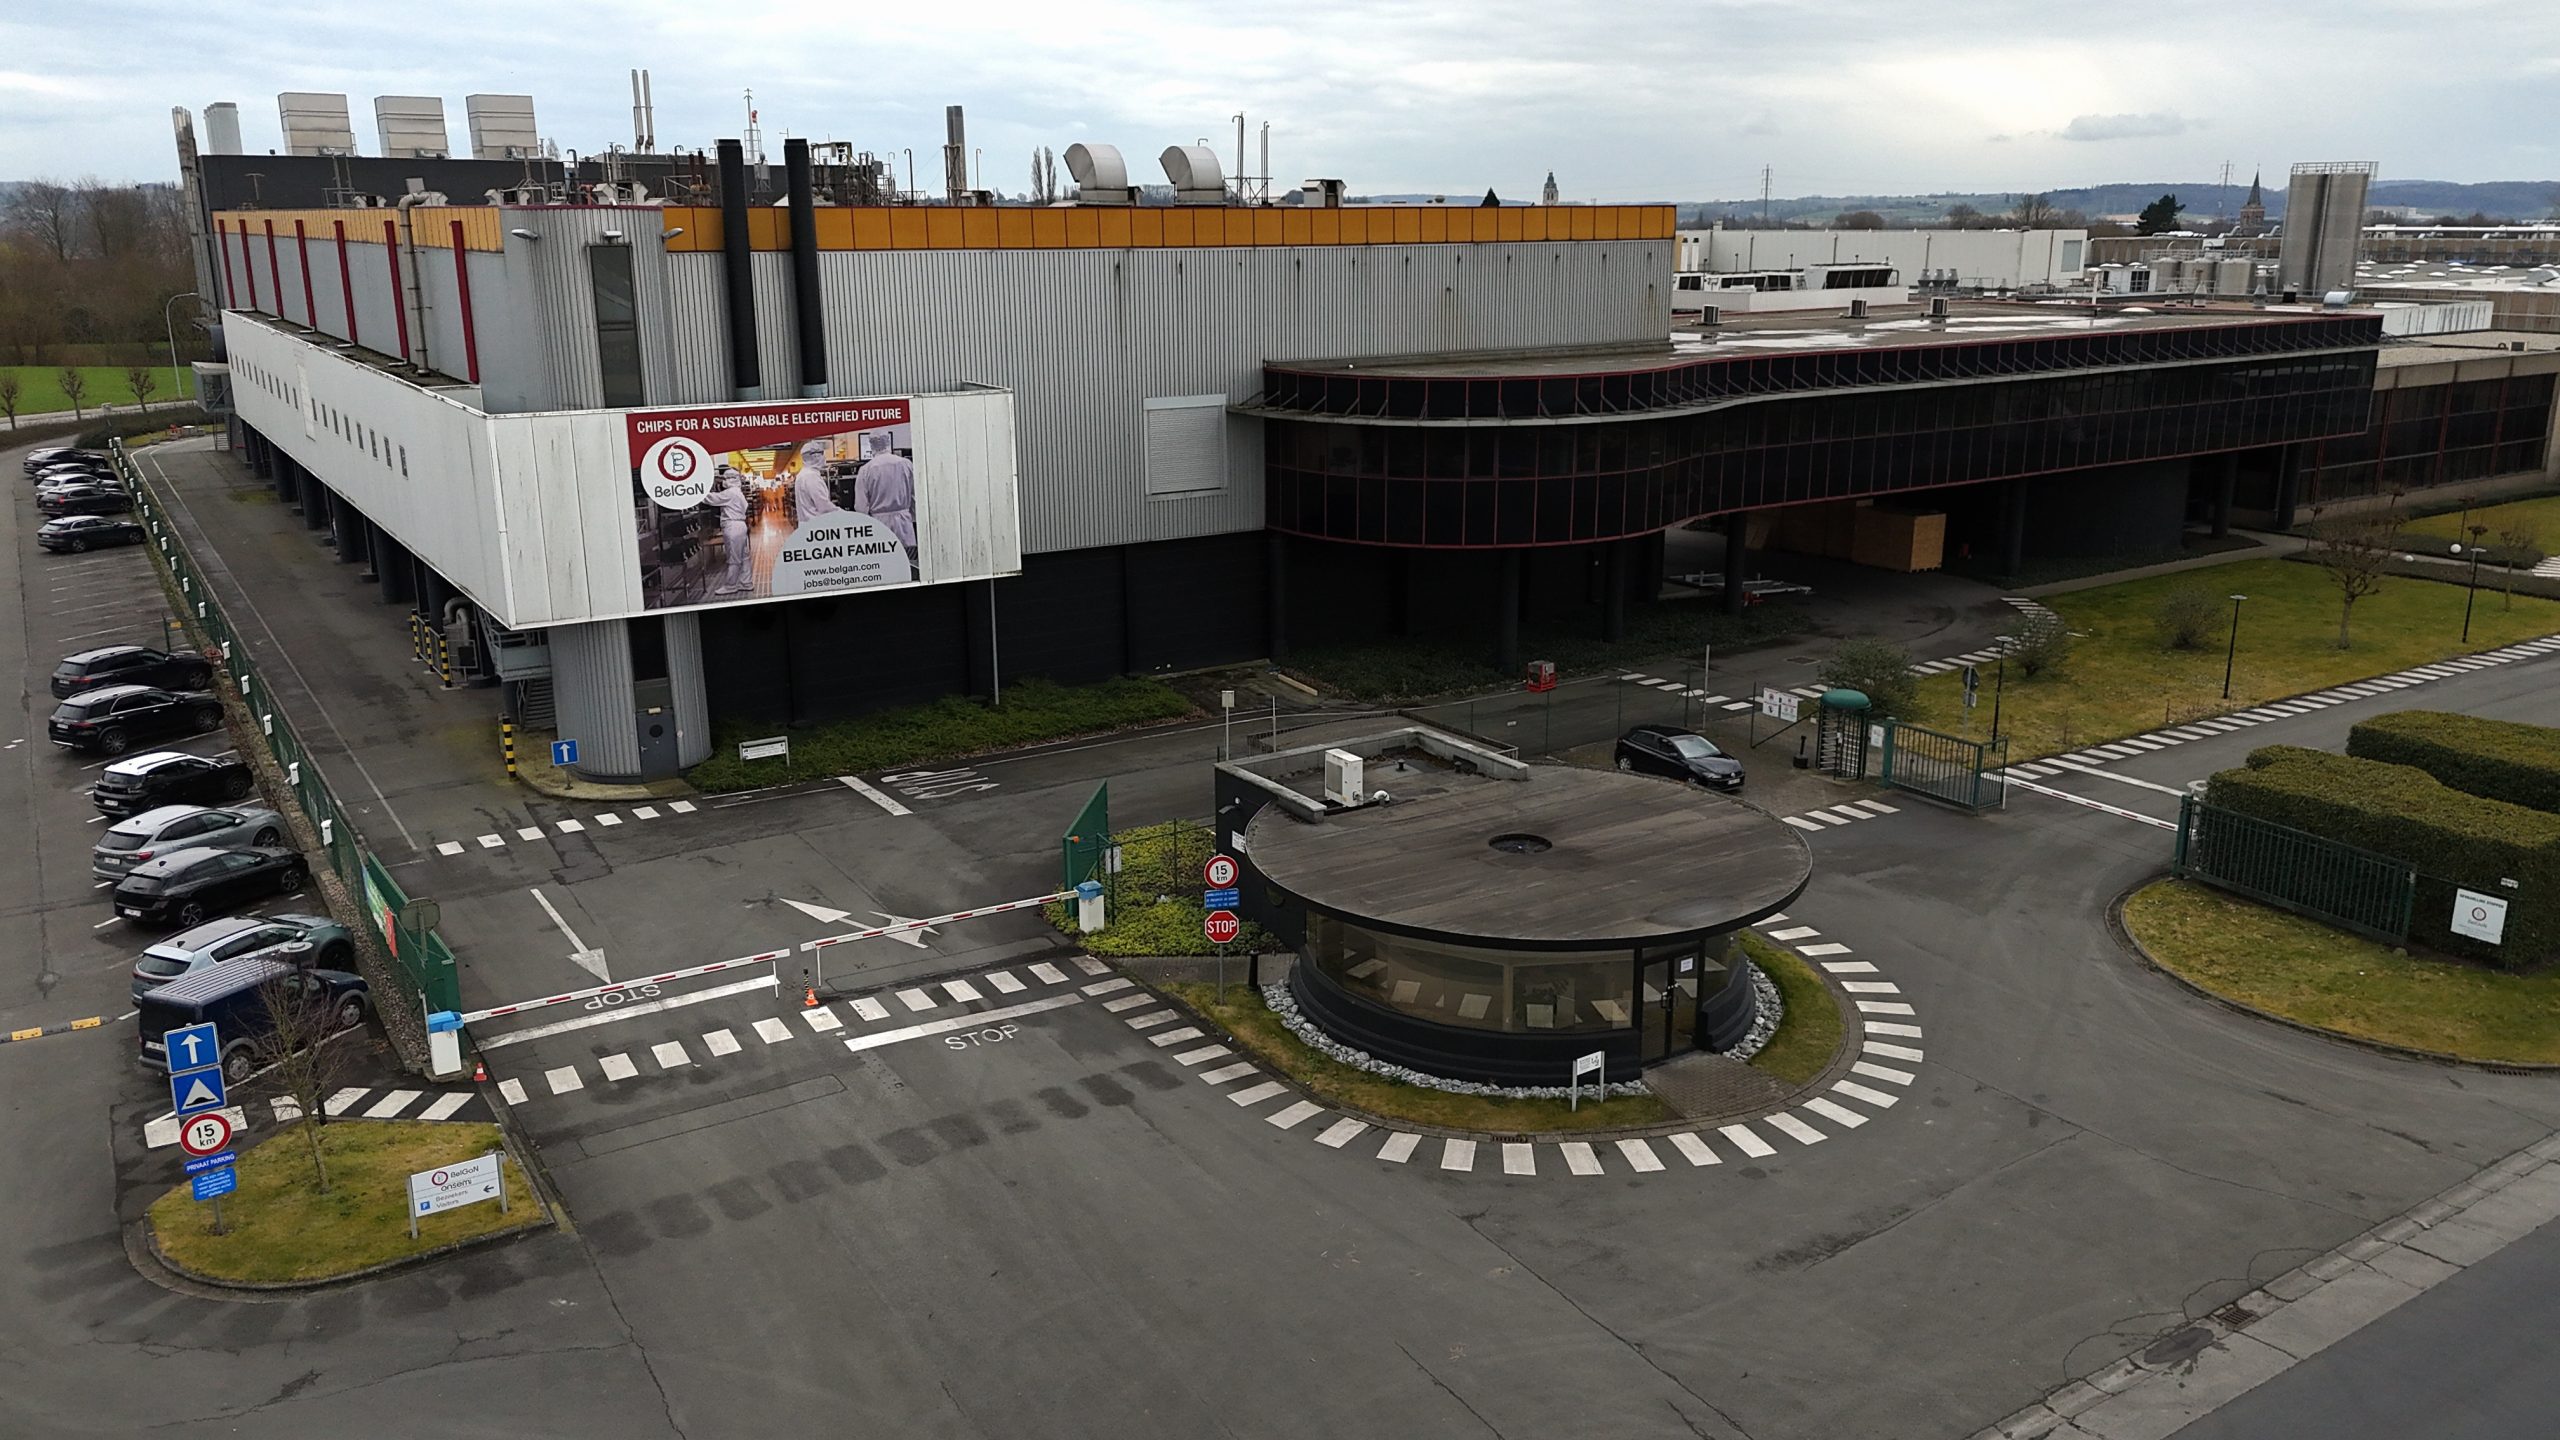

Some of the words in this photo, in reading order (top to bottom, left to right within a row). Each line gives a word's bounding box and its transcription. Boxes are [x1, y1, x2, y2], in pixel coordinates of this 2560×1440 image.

[636, 419, 673, 434] CHIPS
[675, 417, 699, 432] FOR
[701, 417, 710, 430] A
[713, 413, 790, 429] SUSTAINABLE
[792, 409, 859, 425] ELECTRIFIED
[862, 407, 902, 421] FUTURE
[654, 482, 705, 498] BelGaN
[806, 528, 841, 543] JOIN
[844, 525, 873, 539] THE
[783, 545, 843, 563] BELGAN
[847, 541, 897, 557] FAMILY
[803, 562, 880, 577] www.belgan.com
[803, 574, 882, 590] jobs@belgan.com
[1215, 865, 1228, 875] 15
[1207, 920, 1237, 934] STOP
[584, 984, 662, 1010] STOP
[945, 1024, 1019, 1050] STOP
[196, 1124, 215, 1138] 15
[200, 1138, 216, 1147] km
[210, 1154, 235, 1165] PARKING
[441, 1179, 472, 1191] onsemi
